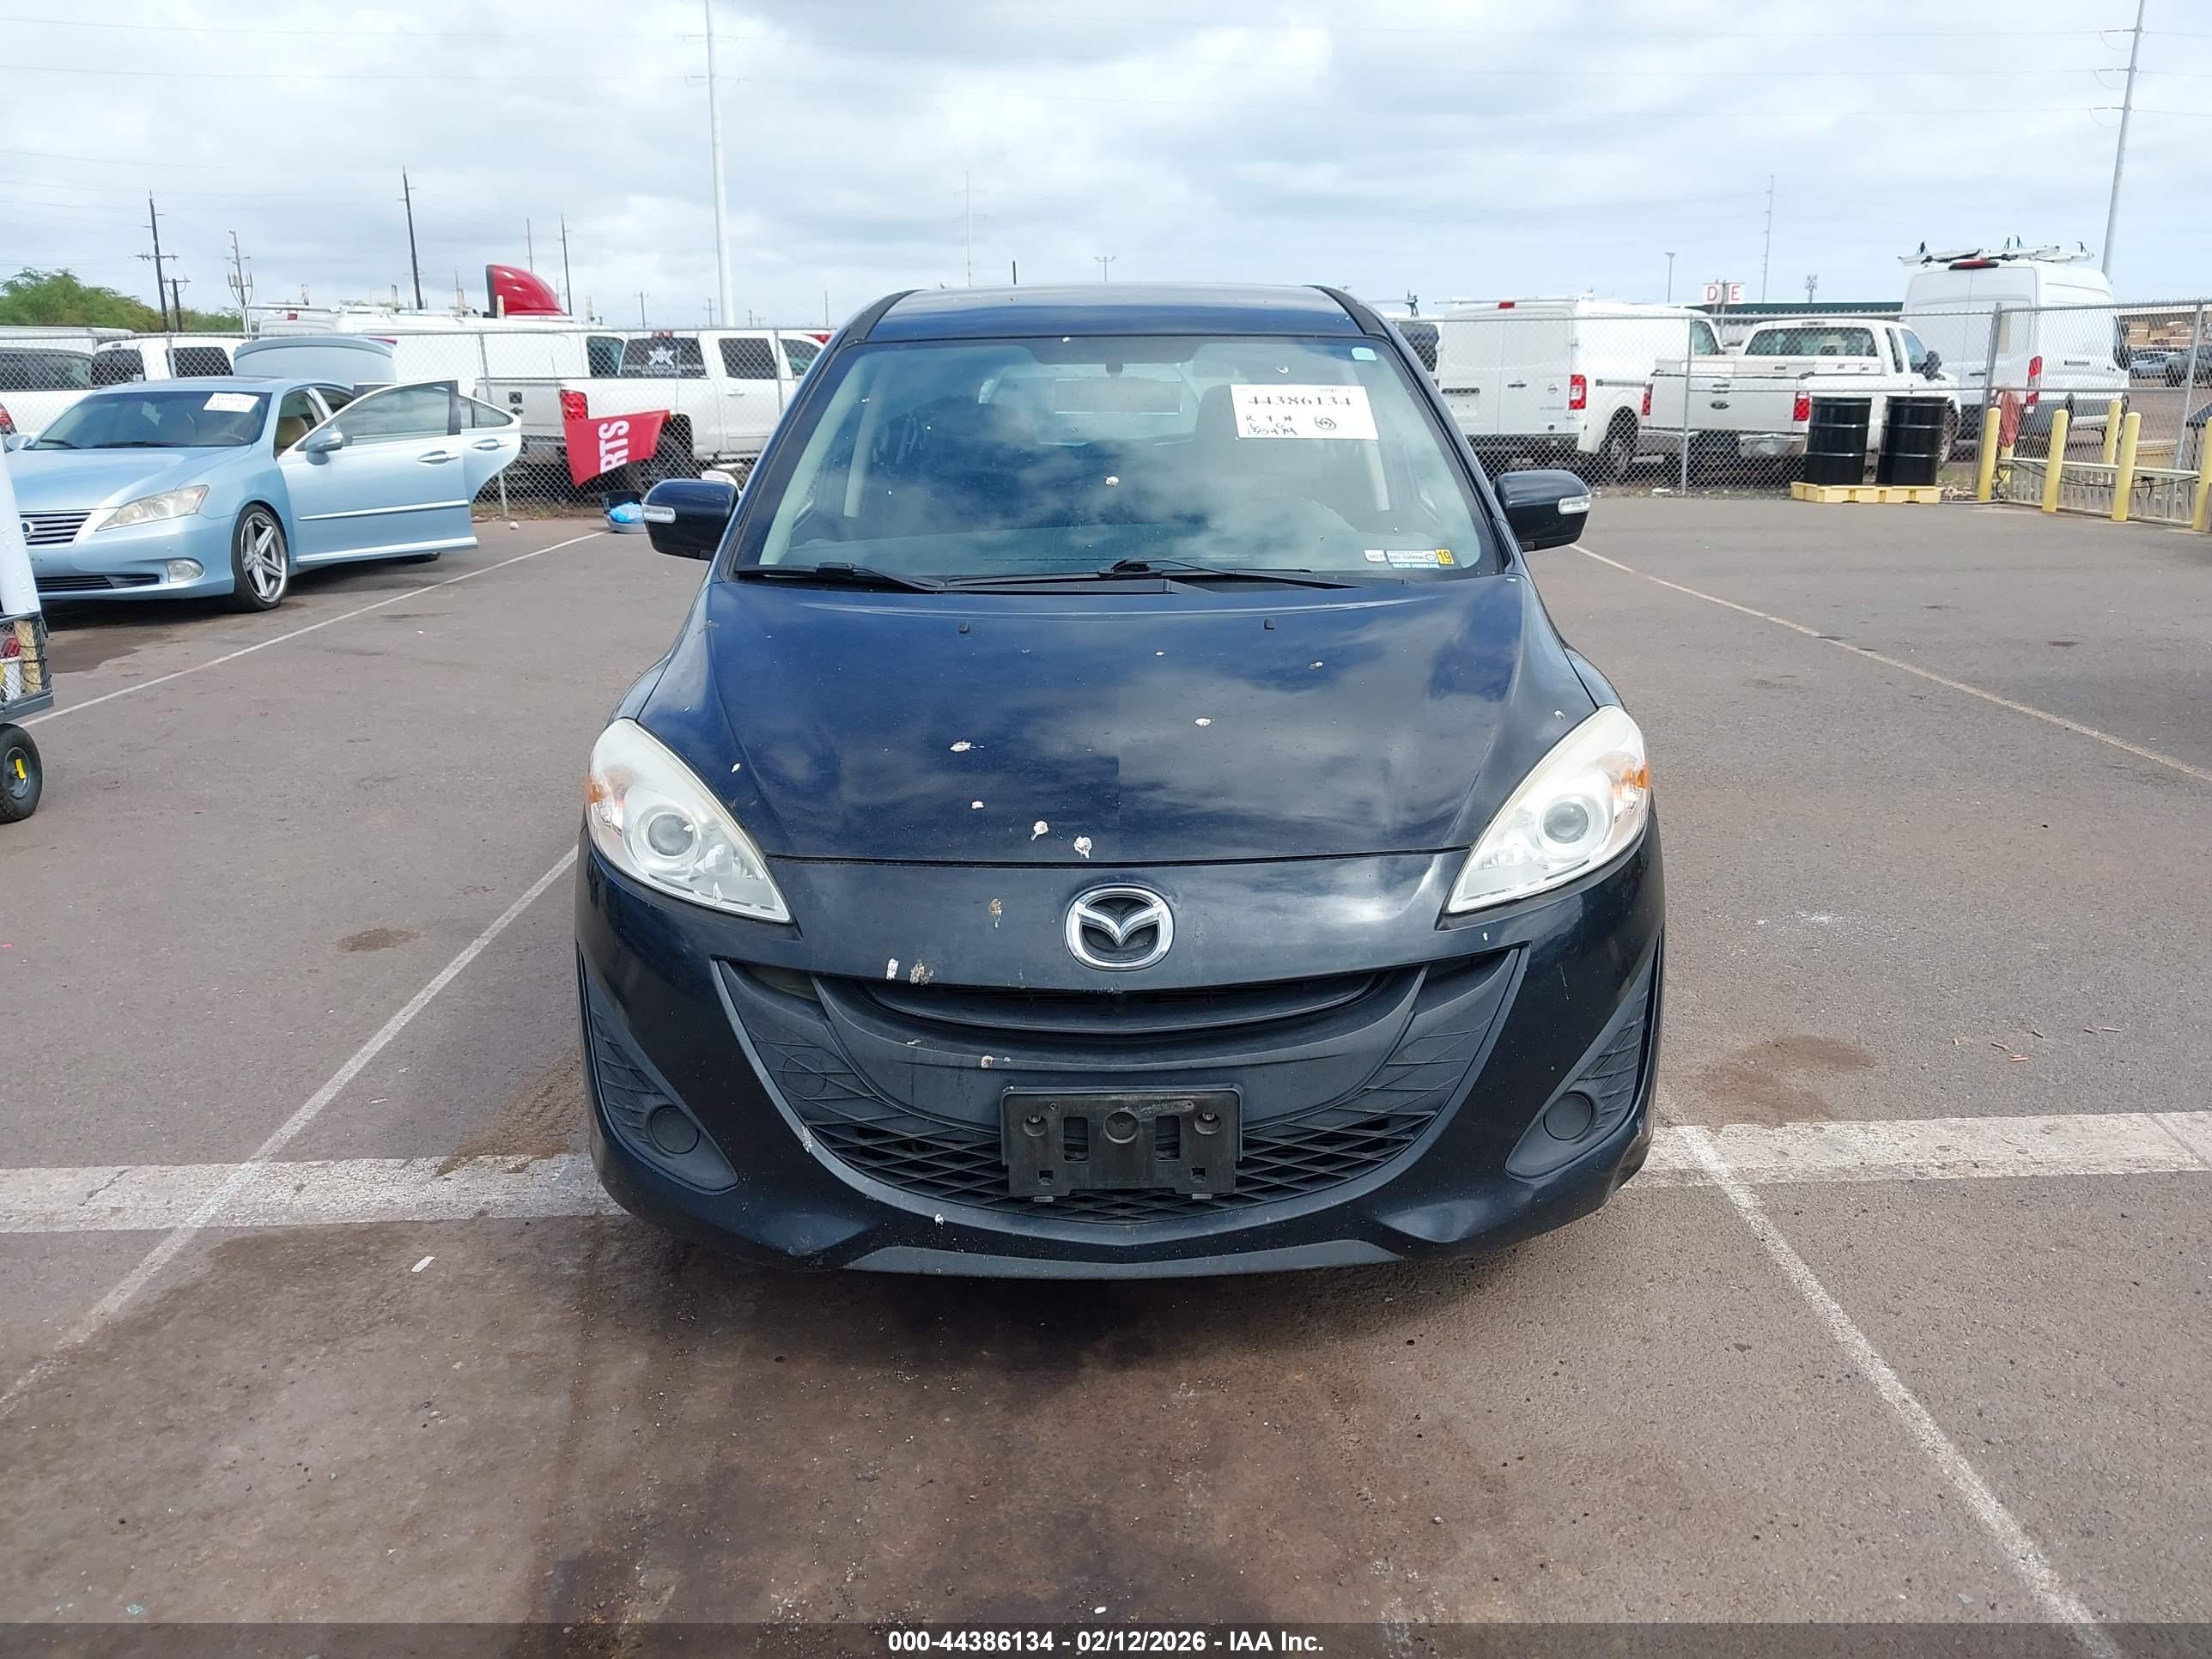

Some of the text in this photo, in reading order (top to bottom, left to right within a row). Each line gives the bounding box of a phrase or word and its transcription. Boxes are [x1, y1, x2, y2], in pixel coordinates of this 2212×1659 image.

[1707, 286, 1717, 301] D
[1730, 285, 1741, 301] E
[1248, 396, 1353, 406] 44386134
[1437, 550, 1452, 563] 19
